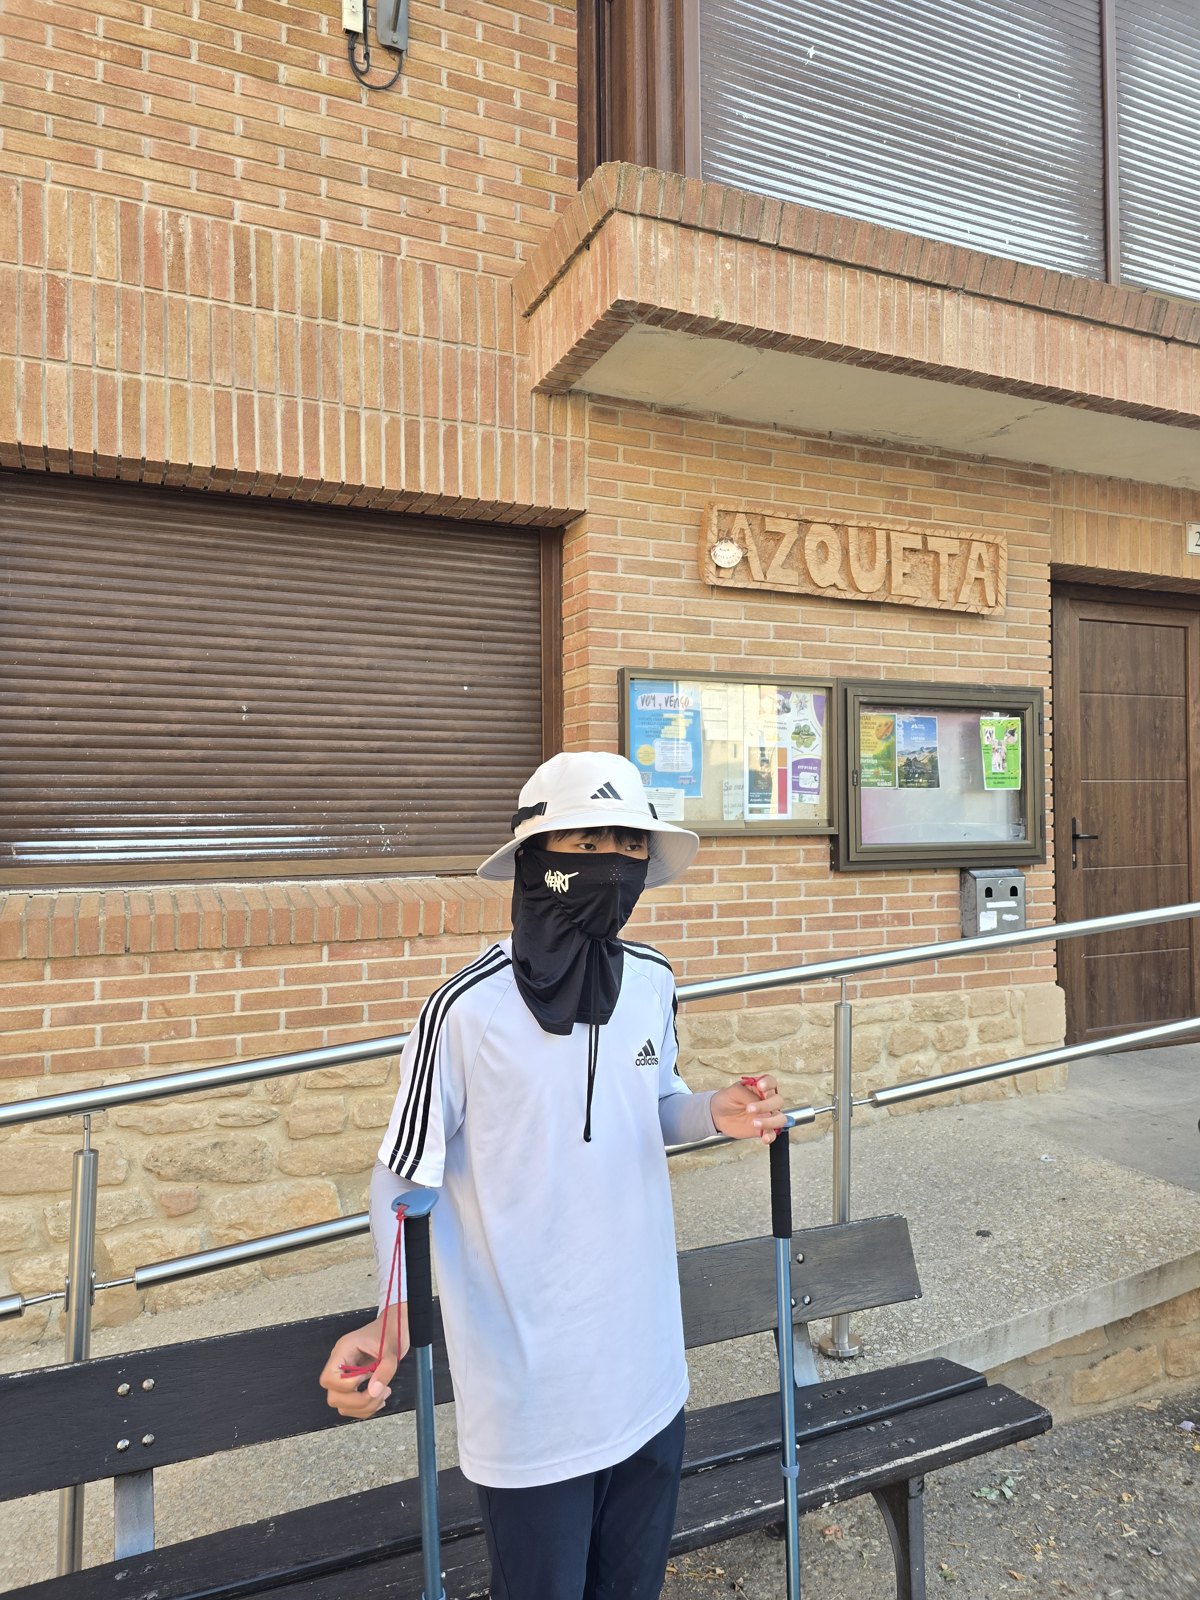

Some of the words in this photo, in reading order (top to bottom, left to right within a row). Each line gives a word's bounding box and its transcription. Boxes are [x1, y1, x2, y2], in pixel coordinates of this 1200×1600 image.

[716, 510, 999, 608] AZQUETA
[640, 694, 656, 708] VOY
[664, 695, 690, 708] VENGO
[635, 1056, 659, 1066] adidas
